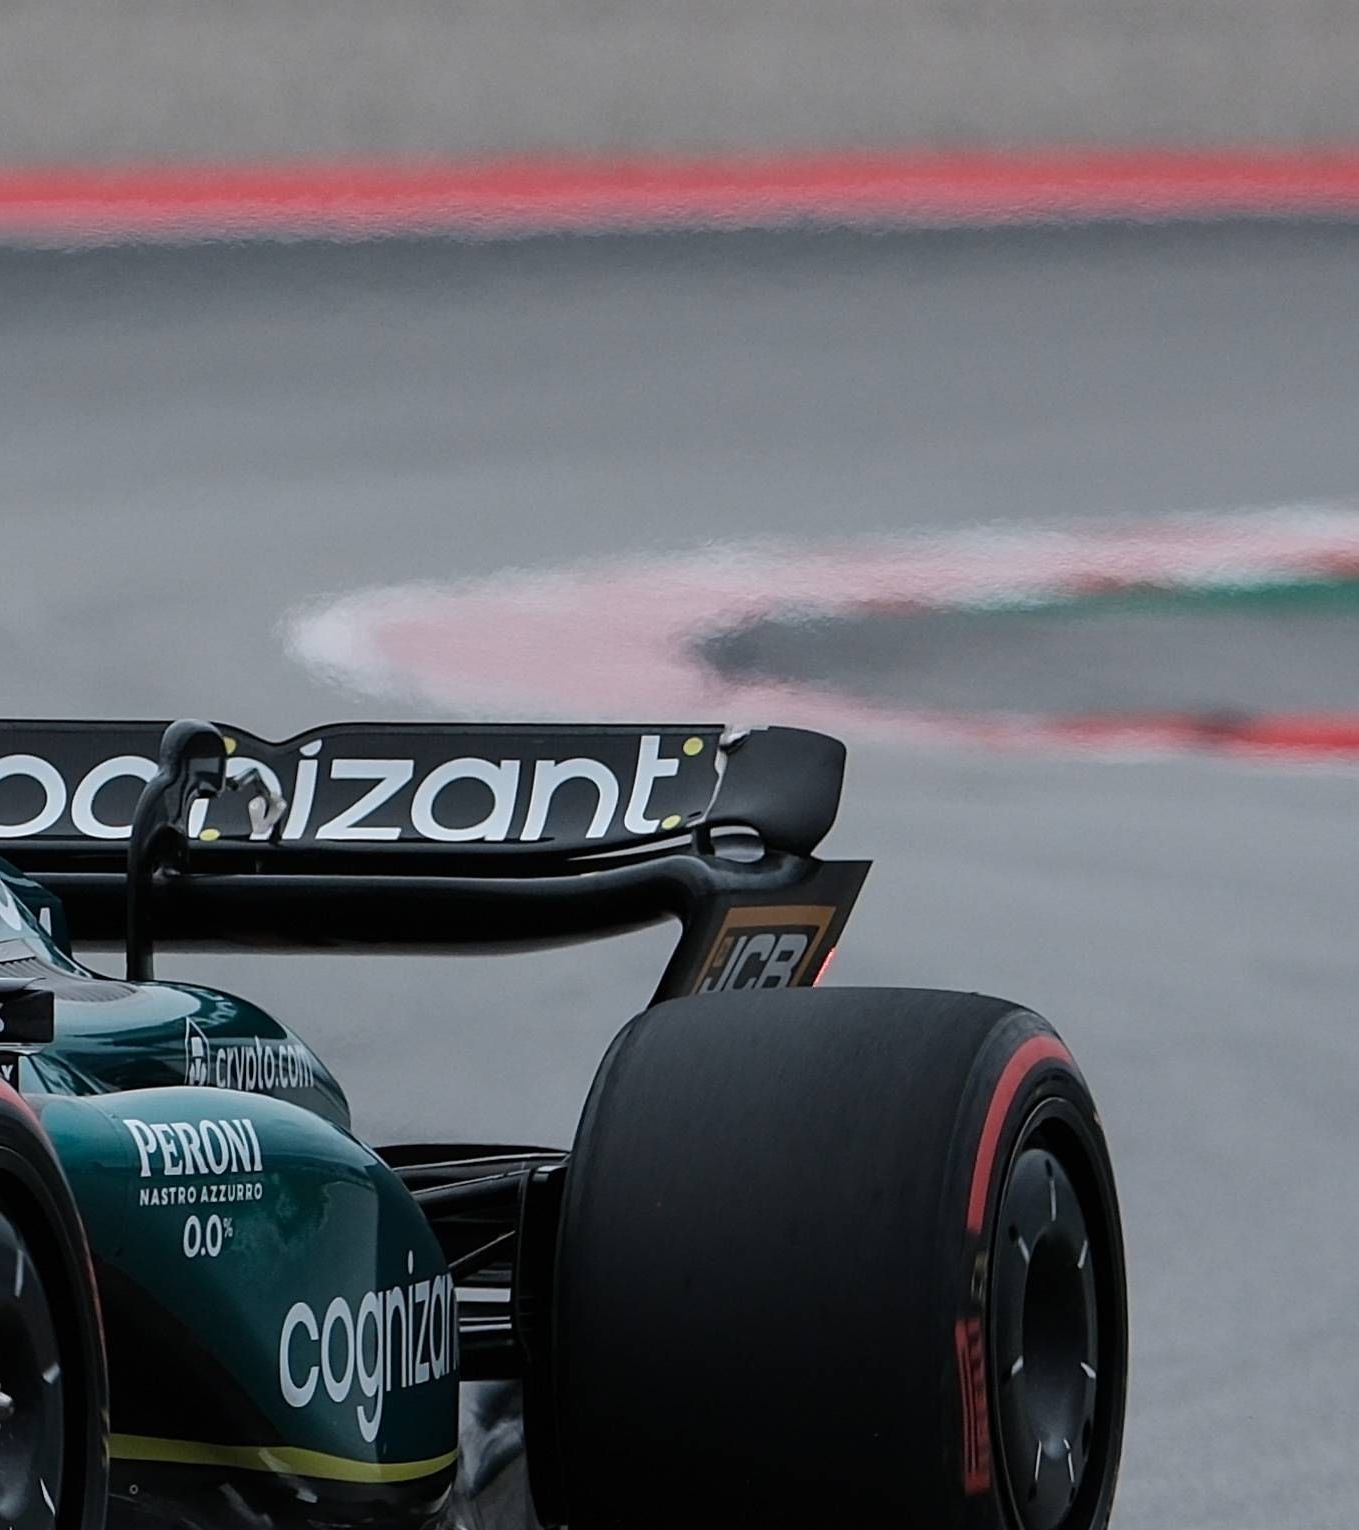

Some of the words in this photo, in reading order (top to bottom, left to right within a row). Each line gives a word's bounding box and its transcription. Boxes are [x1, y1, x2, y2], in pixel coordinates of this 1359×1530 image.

[697, 933, 809, 995] JCB
[216, 1034, 314, 1091] crypto.com
[123, 1117, 263, 1178] PERONI
[139, 1184, 197, 1206] NASTRO
[200, 1182, 264, 1204] AZZURRO
[183, 1213, 234, 1259] 0.0%
[279, 1249, 459, 1443] cognizan
